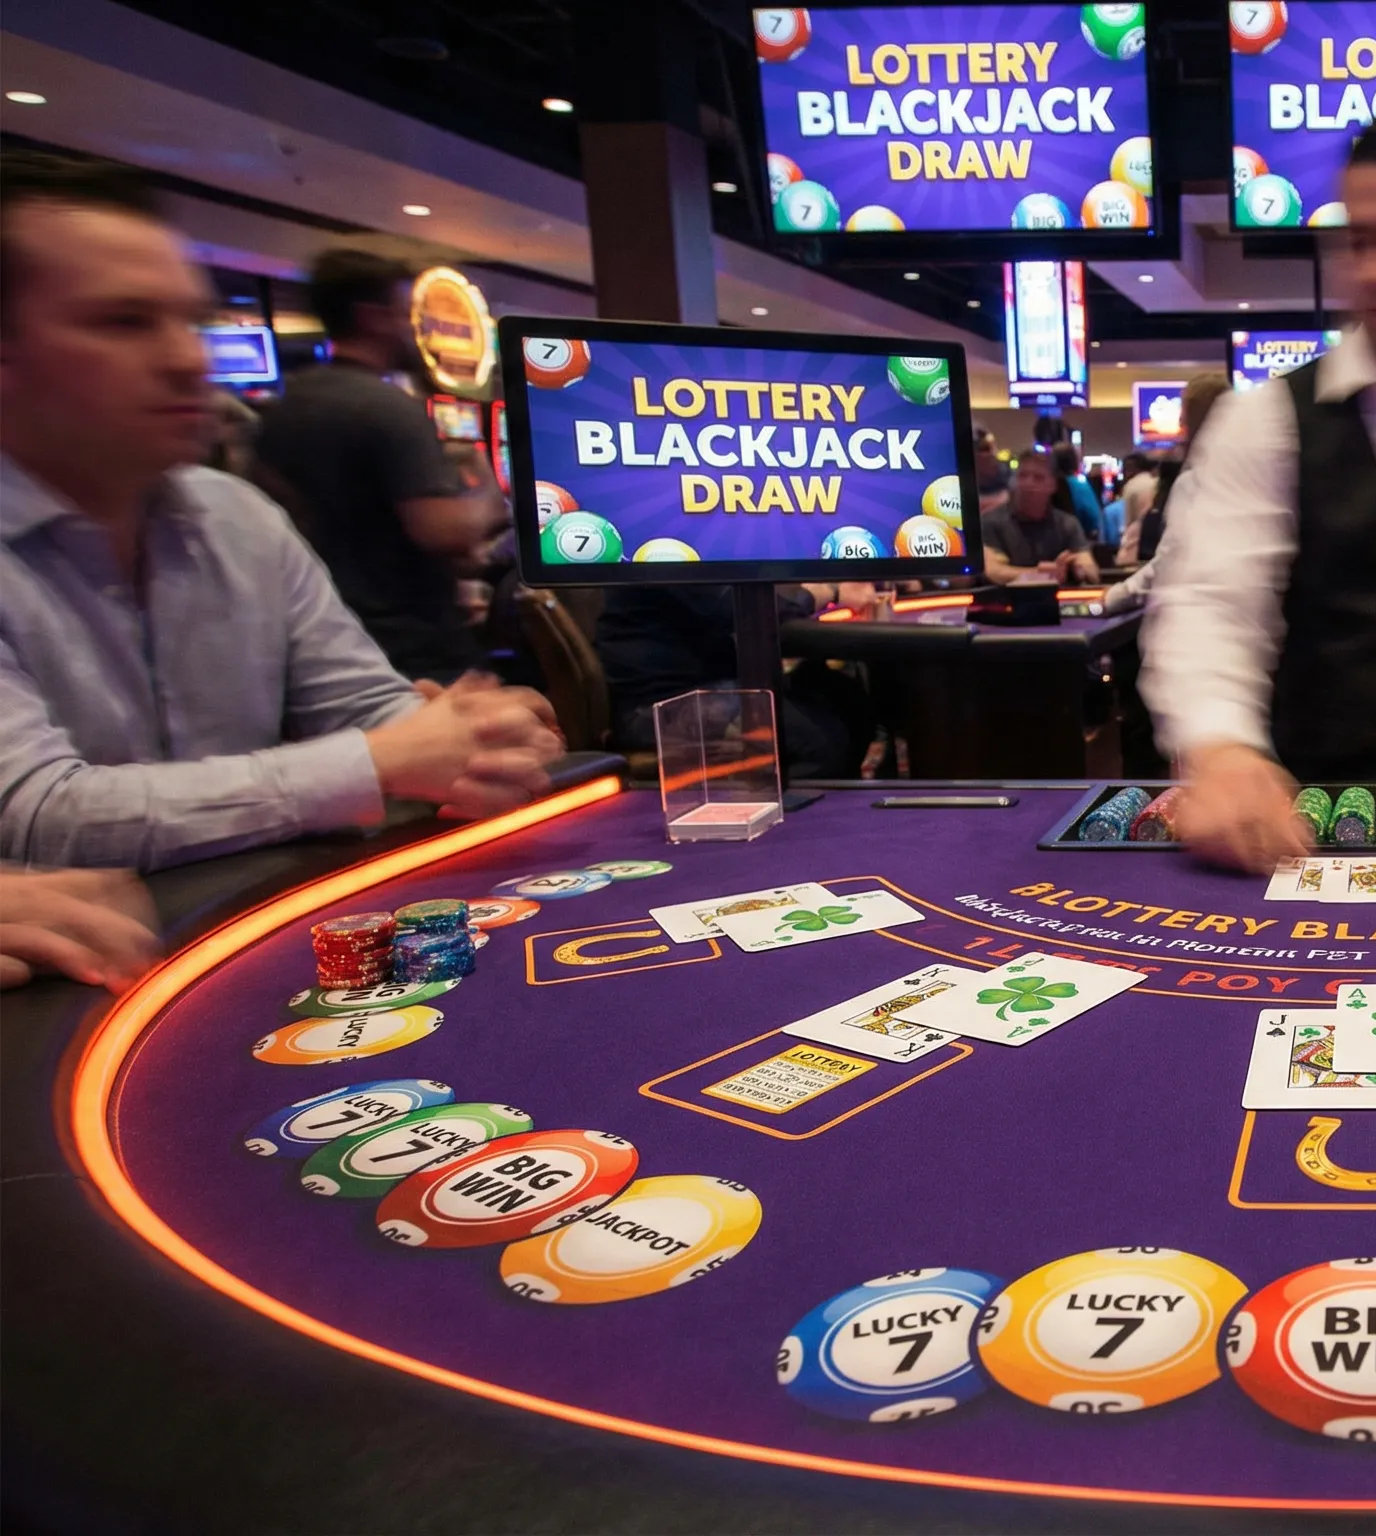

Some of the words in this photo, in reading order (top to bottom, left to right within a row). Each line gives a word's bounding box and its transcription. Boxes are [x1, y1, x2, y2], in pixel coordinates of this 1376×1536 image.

[768, 17, 783, 33] 7
[1246, 9, 1260, 26] 7
[846, 41, 1058, 85] LOTTERY
[798, 87, 1115, 136] BLACKJACK
[888, 139, 1032, 181] DRAW
[801, 205, 812, 220] 7
[1262, 198, 1275, 215] 7
[542, 343, 558, 360] 7
[1256, 340, 1318, 353] LOTTERY
[633, 377, 865, 422] LOTTERY
[575, 420, 925, 470] BLACKJACK
[680, 474, 842, 514] DRAW
[573, 535, 590, 552] 7
[914, 542, 945, 556] WIN
[1176, 971, 1301, 994] POY
[1348, 988, 1367, 999] A
[1269, 1014, 1288, 1026] J
[307, 1110, 365, 1130] 7
[343, 1095, 403, 1120] LUCKY
[410, 1122, 477, 1151] LUCKY
[369, 1138, 435, 1163] 7
[492, 1155, 574, 1192] BIG
[450, 1171, 538, 1215] WIN
[585, 1211, 691, 1256] JACKPOT
[1066, 1293, 1185, 1313] LUCKY
[852, 1305, 964, 1339] LUCKY
[1089, 1317, 1146, 1360] 7
[888, 1331, 934, 1376] 7
